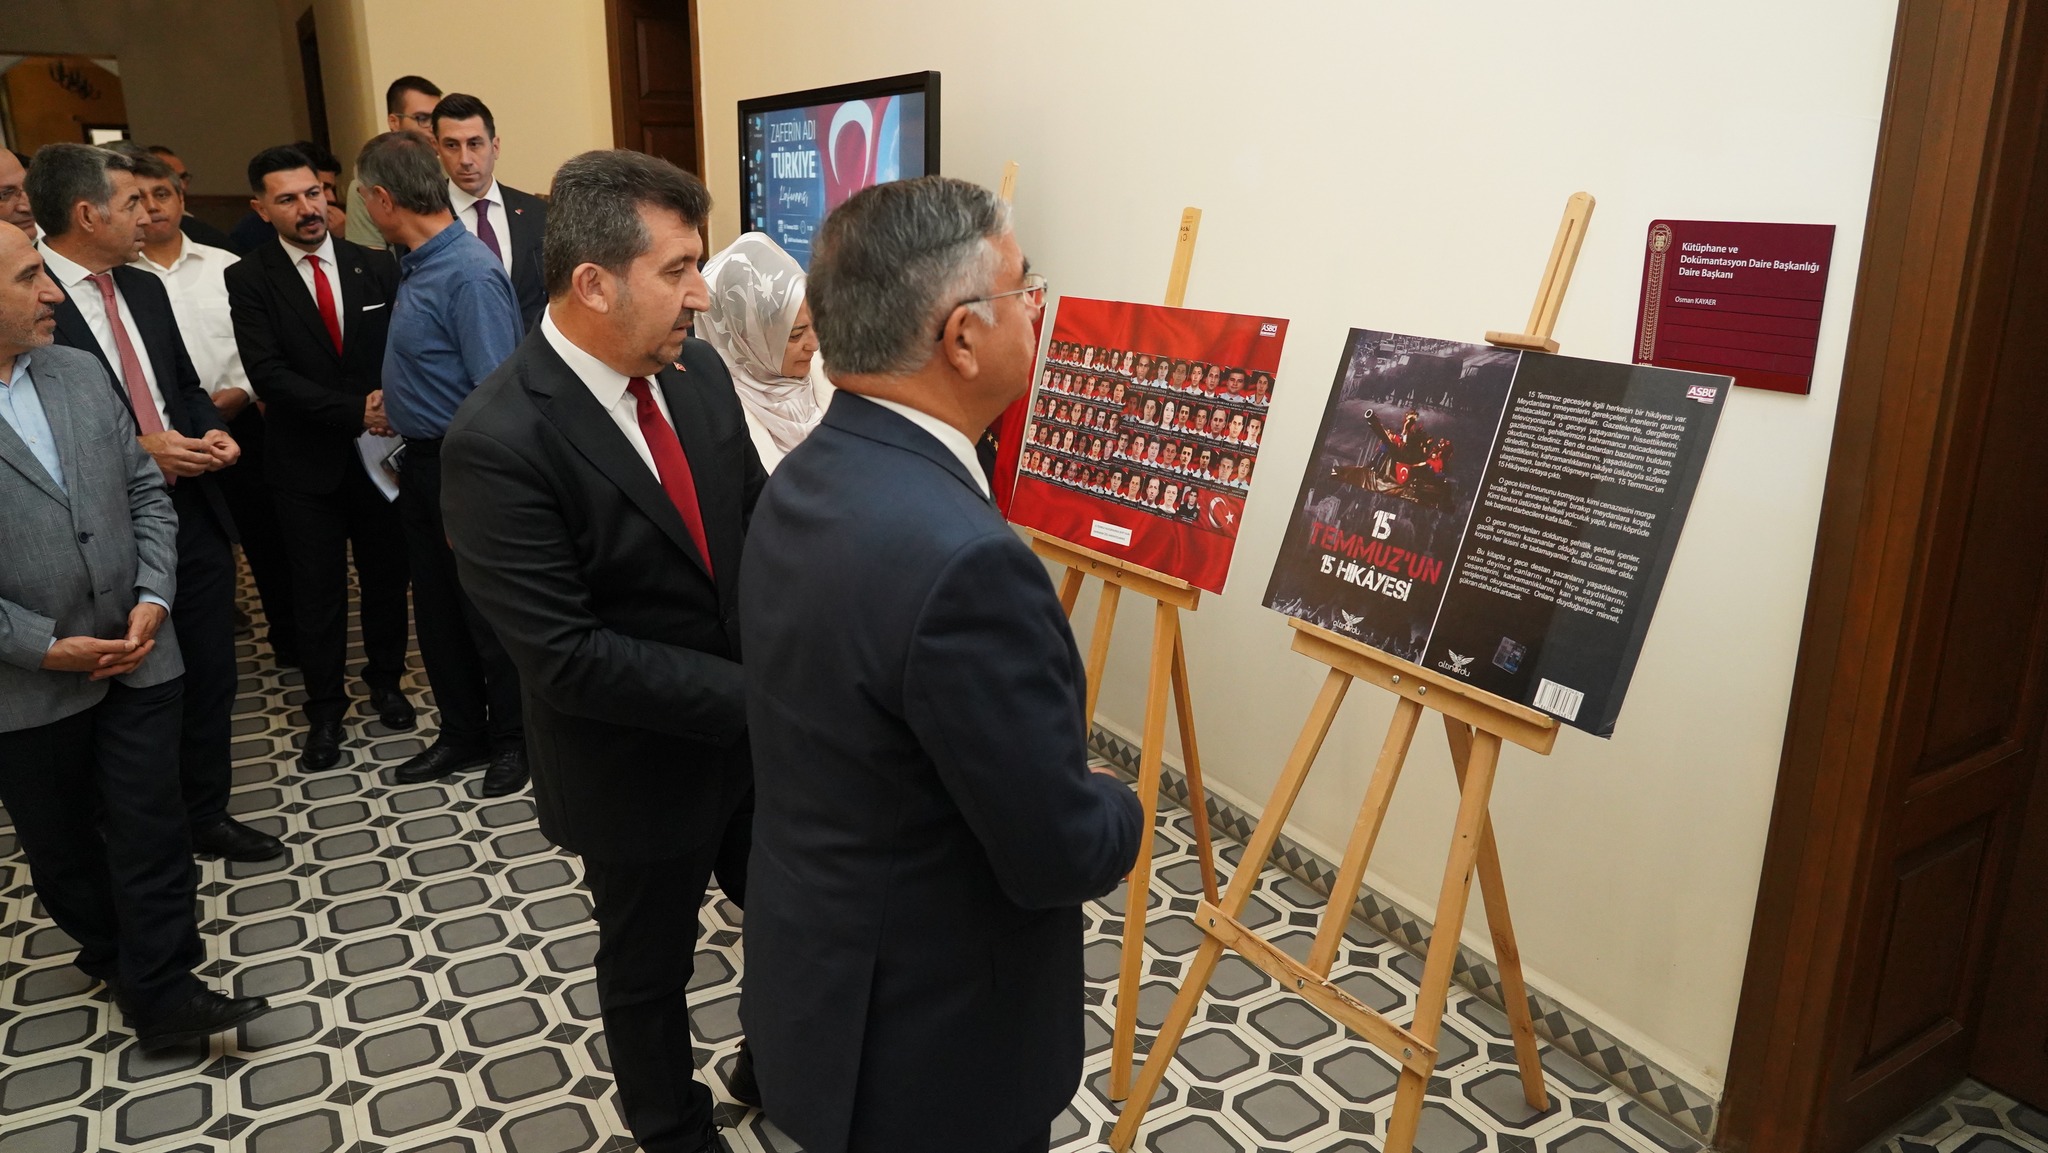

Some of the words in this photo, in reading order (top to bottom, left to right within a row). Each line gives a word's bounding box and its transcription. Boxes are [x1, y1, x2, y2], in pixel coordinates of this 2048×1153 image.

[770, 118, 801, 143] ZAFERİN
[803, 119, 816, 141] ADI
[771, 145, 816, 179] TÜRKİYE
[1680, 254, 1747, 268] Dokümantasyon
[1748, 259, 1772, 269] Daire
[1773, 260, 1820, 273] Başkanlığı
[1681, 242, 1727, 254] Kütüphane
[1728, 245, 1739, 253] ve
[1678, 267, 1701, 277] Daire
[1701, 268, 1734, 280] Başkanı
[1674, 296, 1695, 304] Osman
[1695, 298, 1717, 306] KAYAER
[1537, 391, 1562, 402] Temmuz
[1562, 397, 1592, 408] gecesiyle
[1592, 400, 1606, 410] ilgili
[1605, 403, 1634, 414] herkesin
[1634, 408, 1645, 416] bir
[1674, 415, 1687, 423] var.
[1687, 385, 1717, 398] ASBÜ
[1512, 413, 1556, 427] televizyonlarda
[1565, 423, 1587, 434] geceyi
[1588, 427, 1630, 441] yaşayanların
[1632, 434, 1678, 450] hissettiklerini,
[1516, 396, 1551, 409] Meydanlara
[1552, 402, 1591, 416] inmeyenlerin
[1591, 410, 1628, 423] gerekçeleri,
[1630, 416, 1660, 428] inenlerin
[1660, 422, 1685, 432] gururla
[1602, 419, 1642, 435] Gazetelerde,
[1645, 428, 1681, 442] dergilerde,
[1504, 436, 1530, 448] dinledim,
[1530, 441, 1561, 454] konuştum.
[1602, 457, 1645, 472] yaşadıklarını,
[1652, 467, 1671, 476] gece
[1509, 421, 1546, 434] gazilerimizin,
[1547, 428, 1587, 441] şehitlerimizin
[1587, 434, 1627, 449] kahramanca
[1627, 444, 1677, 458] mücadelelerini
[1563, 438, 1577, 448] Ben
[1586, 444, 1614, 456] onlardan
[1614, 449, 1645, 462] bazılarını
[1645, 455, 1672, 468] buldum,
[1499, 452, 1533, 466] ulaştırmaya,
[1534, 459, 1551, 469] tarihe
[1551, 463, 1562, 471] not
[1561, 465, 1590, 478] düşmeye
[1590, 472, 1616, 483] çalıştım.
[1627, 478, 1665, 494] Temmuz'un
[1501, 444, 1539, 459] hissettiklerini,
[1540, 451, 1592, 469] kahramanlıklarını
[1644, 474, 1668, 485] sizlere
[1529, 467, 1548, 477] ortaya
[1547, 471, 1562, 480] çıktı.
[1484, 499, 1494, 507] tek
[1493, 500, 1513, 512] başına
[1512, 506, 1545, 520] darbecilere
[1544, 513, 1558, 523] kafa
[1486, 490, 1501, 500] Kimi
[1500, 494, 1518, 504] tankın
[1518, 498, 1542, 510] üstünde
[1541, 504, 1565, 516] tehlikeli
[1564, 510, 1590, 523] yolculuk
[1589, 517, 1608, 528] yaptı,
[1608, 520, 1623, 530] kimi
[1622, 524, 1650, 537] köprüde
[1489, 483, 1509, 494] bıraktı,
[1510, 487, 1524, 497] kimi
[1524, 492, 1551, 504] annesini,
[1552, 498, 1568, 507] eşini
[1569, 501, 1591, 514] bırakıp
[1592, 508, 1631, 523] meydanlara
[1632, 516, 1652, 528] koştu.
[1503, 479, 1519, 487] gece
[1518, 481, 1531, 490] kimi
[1530, 484, 1557, 496] torununu
[1556, 489, 1585, 504] komşuya,
[1586, 496, 1600, 506] kimi
[1599, 501, 1634, 515] cenazesini
[1634, 509, 1656, 520] morga
[1372, 509, 1396, 541] 15
[1492, 518, 1507, 527] gece
[1541, 530, 1569, 544] doldurup
[1570, 539, 1592, 550] şehitlik
[1593, 545, 1616, 556] şerbeti
[1617, 550, 1640, 564] içenler,
[1310, 521, 1444, 585] TEMMUZ'UN
[1474, 529, 1492, 541] koyup
[1492, 534, 1503, 543] her
[1502, 537, 1520, 547] ikisini
[1528, 544, 1570, 563] tadamayanlar,
[1571, 555, 1588, 567] buna
[1588, 561, 1618, 575] üzülenler
[1618, 570, 1634, 580] oldu.
[1476, 523, 1495, 532] gazilik
[1496, 528, 1522, 539] unvanını
[1523, 533, 1556, 548] kazananlar
[1557, 544, 1579, 556] olduğu
[1580, 550, 1593, 559] gibi
[1594, 555, 1615, 565] canını
[1616, 561, 1638, 572] ortaya
[1320, 554, 1337, 576] 15
[1336, 558, 1413, 602] HİKÂYESİ
[1459, 576, 1478, 587] şükran
[1477, 581, 1492, 592] daha
[1499, 589, 1522, 601] artacak.
[1464, 561, 1500, 579] cesaretlerini,
[1503, 571, 1556, 595] kahramanlıklarını,
[1559, 588, 1572, 598] kan
[1574, 594, 1607, 610] verişlerini,
[1610, 606, 1624, 615] can
[1467, 554, 1484, 564] vatan
[1486, 558, 1511, 573] deyince
[1513, 567, 1543, 580] canlarını
[1544, 576, 1563, 586] nasıl
[1564, 581, 1580, 592] hiçe
[1582, 588, 1625, 607] saydıklarını,
[1486, 549, 1506, 561] kitapta
[1513, 558, 1529, 568] gece
[1530, 562, 1551, 574] destan
[1552, 570, 1585, 584] yazanların
[1585, 580, 1628, 599] yaşadıklarını,
[1462, 569, 1488, 582] verişlerini
[1489, 577, 1531, 595] okuyacaksınız.
[1533, 589, 1554, 602] Onlara
[1556, 597, 1594, 615] duyduğunuz
[1596, 610, 1619, 624] minnet,
